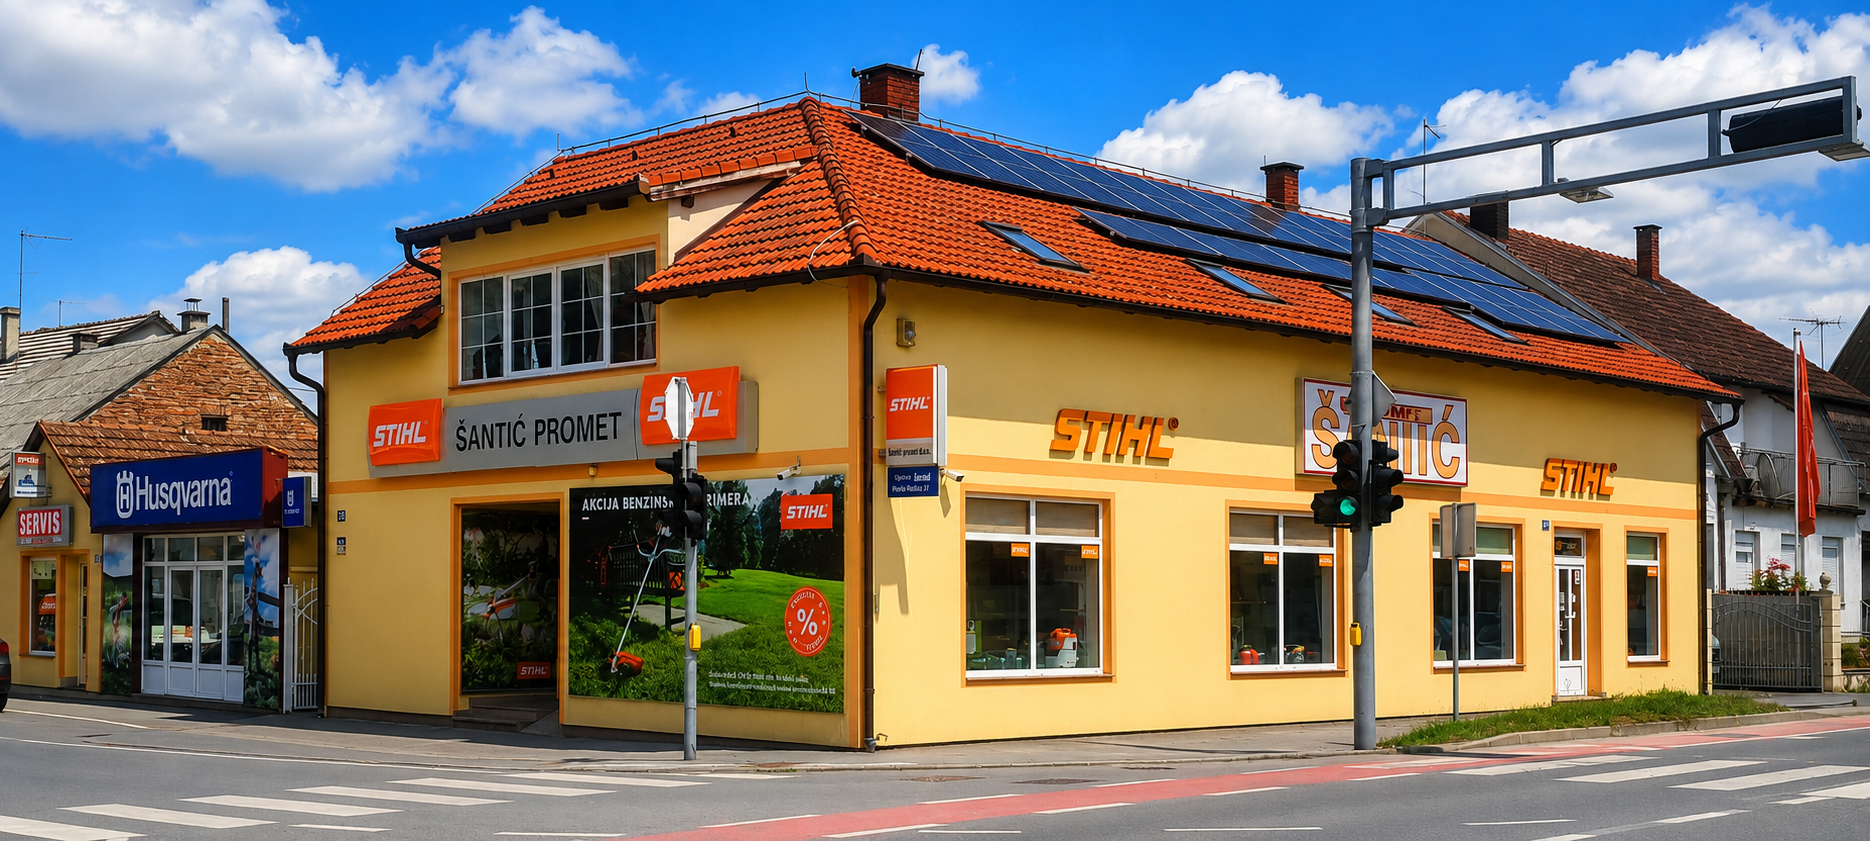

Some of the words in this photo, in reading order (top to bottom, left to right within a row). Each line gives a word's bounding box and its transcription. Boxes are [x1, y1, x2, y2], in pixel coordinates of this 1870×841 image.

[889, 396, 929, 412] STIHL
[373, 421, 426, 447] STIHL
[455, 413, 527, 452] ŠANTIĆ
[534, 411, 622, 446] PROMET
[1049, 408, 1175, 459] STIHL
[1541, 457, 1615, 496] STIHL
[136, 475, 232, 516] Husqvarna
[582, 498, 619, 511] AKCIJA
[19, 511, 61, 535] SERVIS
[787, 504, 828, 519] STIHL
[520, 666, 547, 675] STIHL
